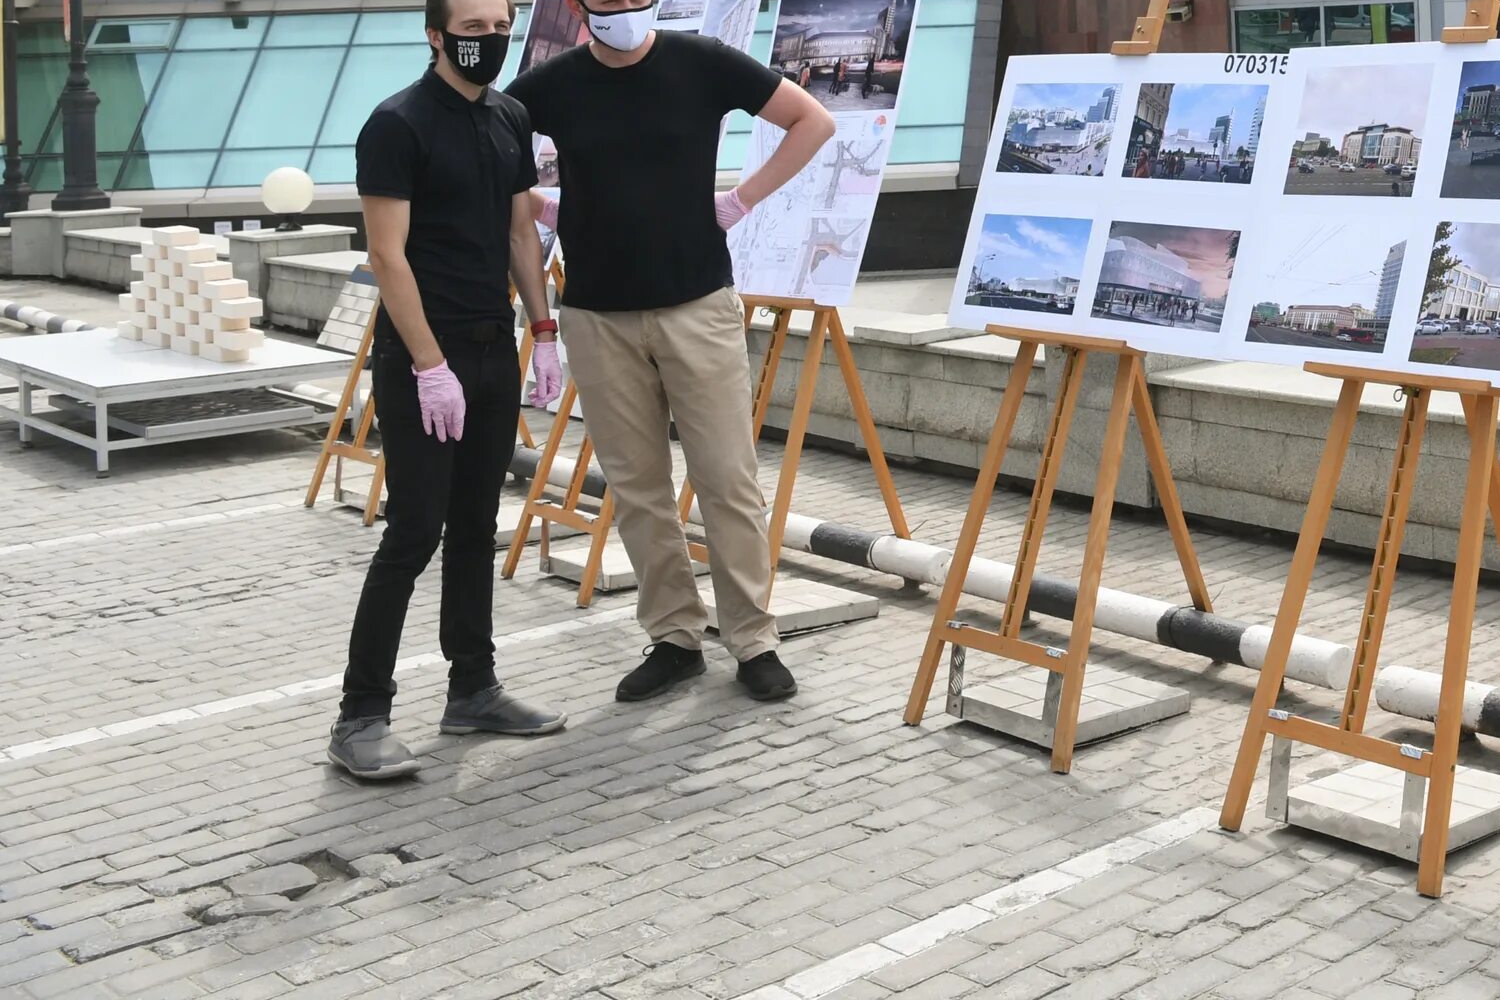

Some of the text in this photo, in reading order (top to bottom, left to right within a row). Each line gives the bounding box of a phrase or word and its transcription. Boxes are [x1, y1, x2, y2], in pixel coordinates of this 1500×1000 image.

[457, 46, 480, 56] GIVE
[458, 55, 481, 68] UP
[1224, 54, 1289, 75] 070315
